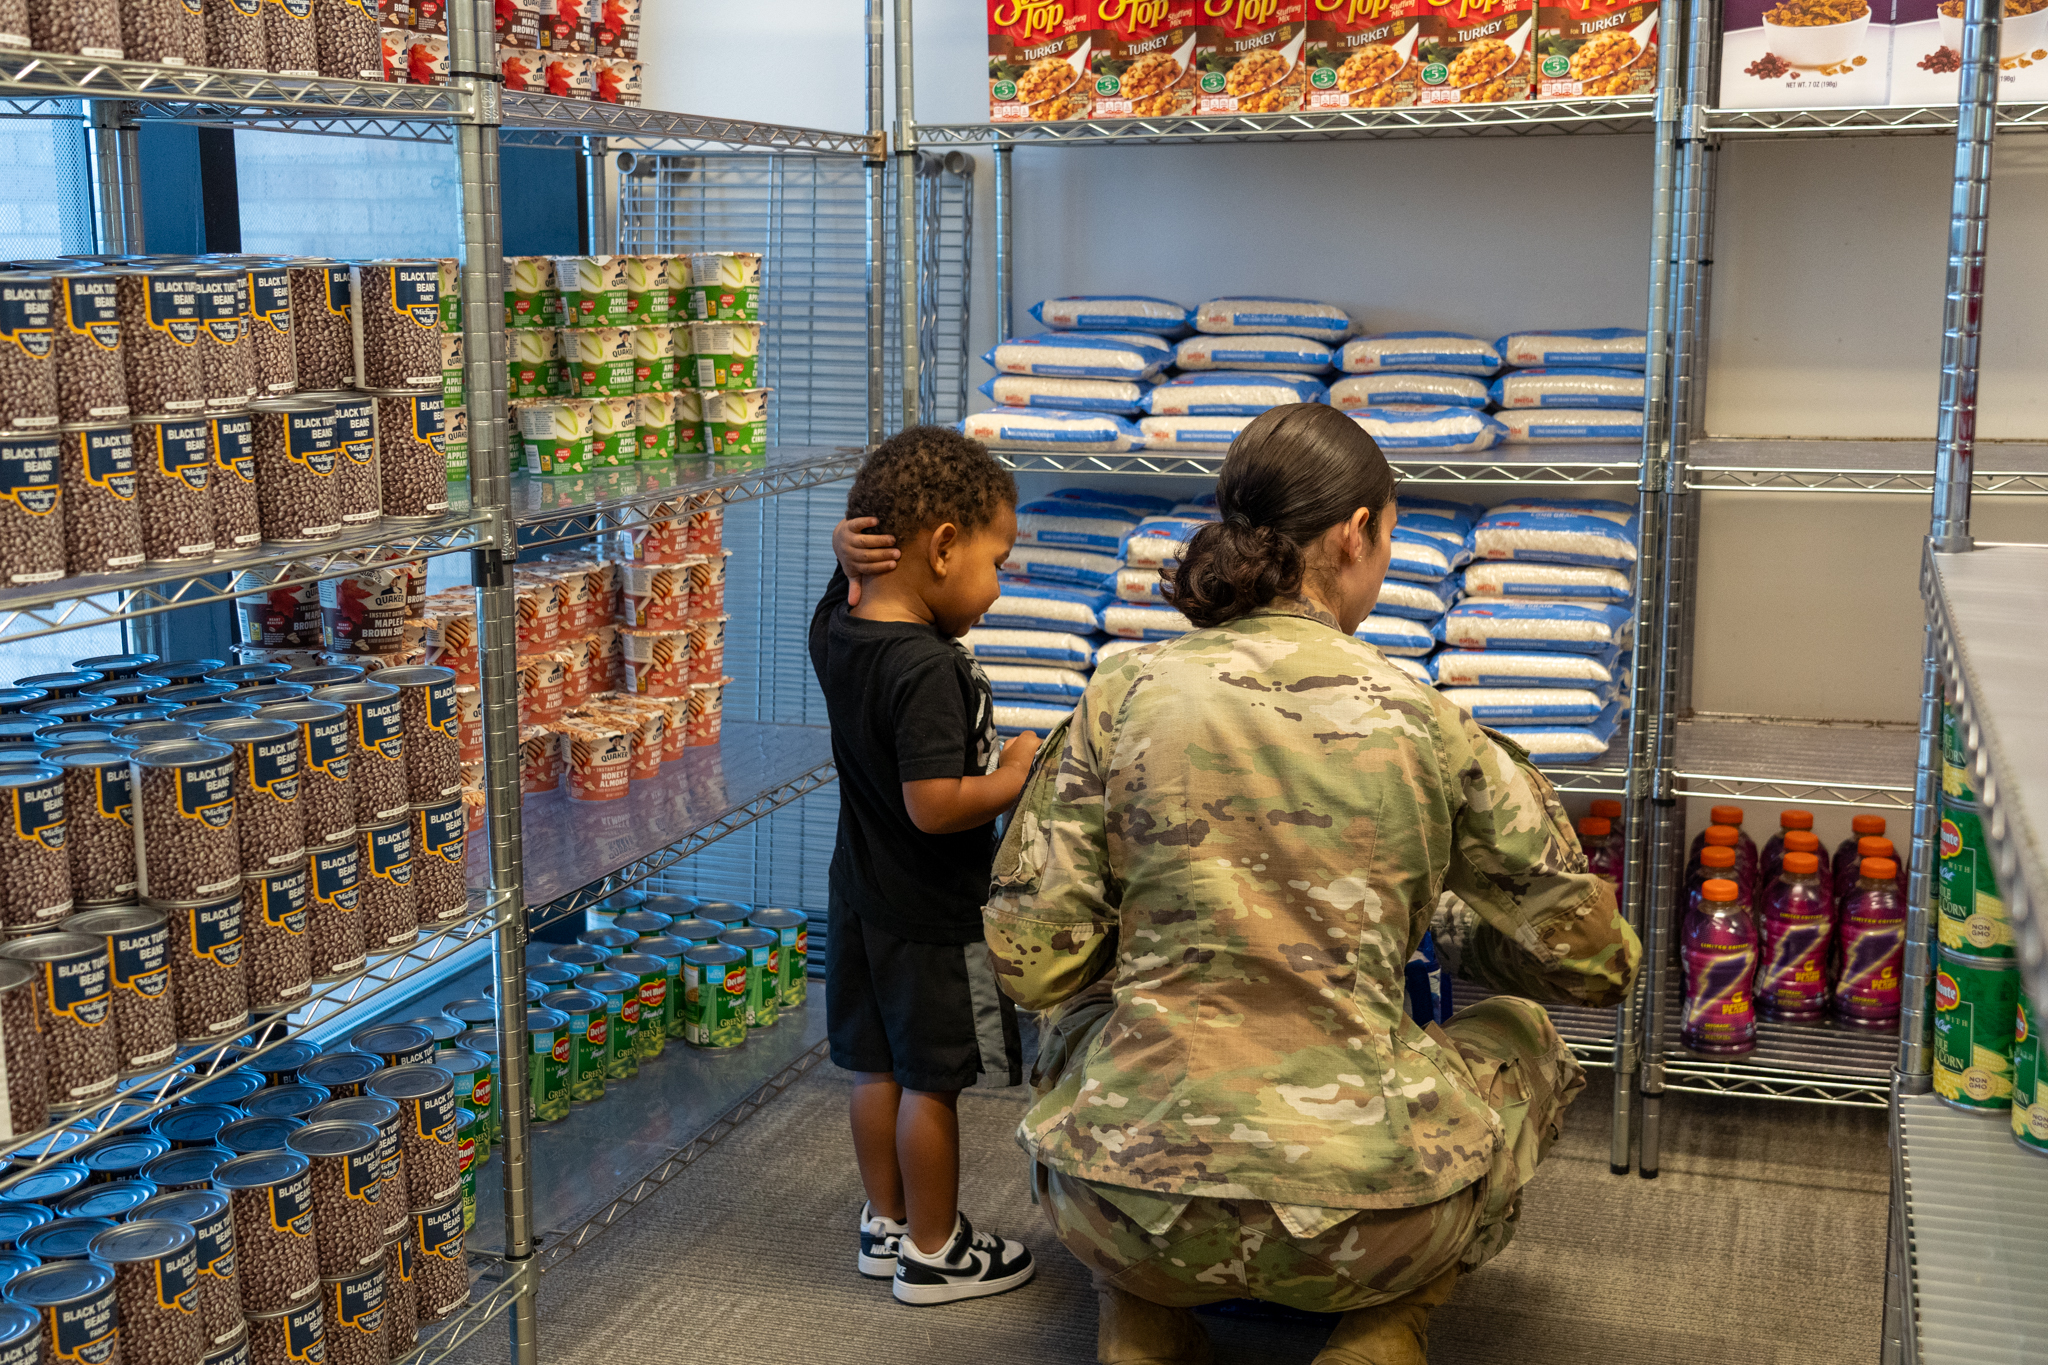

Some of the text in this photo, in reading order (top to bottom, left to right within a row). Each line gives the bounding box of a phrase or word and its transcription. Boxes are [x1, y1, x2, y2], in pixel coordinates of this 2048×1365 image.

[1580, 12, 1627, 35] TURKEY
[1346, 26, 1389, 47] TURKEY
[1458, 20, 1502, 42] TURKEY
[1128, 35, 1169, 56] TURKEY
[1234, 31, 1277, 52] TURKEY
[1023, 40, 1064, 61] TURKEY
[1552, 62, 1560, 72] 5
[1320, 74, 1328, 83] 5
[1431, 69, 1439, 79] 5
[1105, 82, 1112, 91] 5
[1210, 78, 1217, 88] 5
[1820, 81, 1838, 89] (198g)
[1001, 86, 1009, 95] 5
[258, 277, 280, 287] BLACK
[400, 272, 439, 282] BLACK TURT
[75, 284, 104, 295] BLACK
[155, 281, 184, 293] BLACK
[416, 283, 435, 293] BEANS
[3, 288, 37, 301] BLACK
[173, 294, 195, 305] BEANS
[213, 294, 235, 305] BEANS
[420, 401, 440, 411] BLACK
[335, 407, 359, 419] BLACK
[222, 423, 244, 434] BLACK
[294, 415, 336, 429] BLACK TURT
[350, 418, 370, 429] BEANS
[167, 428, 195, 440] BLACK
[311, 428, 333, 439] BEANS
[354, 430, 368, 438] FANCY
[92, 435, 121, 448] BLACK
[316, 440, 331, 448] FANCY
[2, 447, 37, 460] BLACK
[23, 460, 52, 473] BEANS
[375, 594, 404, 606] QUAKER
[374, 619, 398, 628] MAPLE
[362, 628, 393, 638] BROWN
[434, 688, 453, 700] BLACK
[367, 705, 391, 718] BLACK
[383, 713, 400, 727] BEANS
[315, 725, 339, 738] BLACK
[259, 743, 285, 757] BLACK
[601, 751, 628, 762] QUAKER
[276, 751, 297, 766] BEANS
[186, 768, 217, 783] BLACK
[601, 771, 624, 780] HONEY
[206, 776, 230, 792] BEANS
[600, 777, 628, 788] ALMONDS
[24, 787, 54, 803] BLACK
[430, 812, 453, 825] BLACK
[445, 819, 462, 832] BEANS
[377, 832, 401, 846] BLACK
[449, 829, 461, 839] FANCY
[393, 840, 410, 853] BEANS
[321, 856, 346, 870] BLACK
[397, 852, 410, 861] FANCY
[338, 864, 357, 878] BEANS
[1948, 862, 1971, 874] WITH
[272, 878, 297, 892] BLACK
[342, 875, 356, 886] FANCY
[1942, 898, 1967, 918] CORN
[201, 909, 229, 924] BLACK
[219, 914, 240, 932] BEANS
[1971, 923, 1991, 932] NON
[1971, 929, 1991, 938] GMO
[119, 927, 169, 952] BLACK TURT
[139, 942, 164, 960] BEANS
[144, 957, 163, 970] FANCY
[58, 963, 90, 978] BLACK
[79, 969, 105, 987] BEANS
[85, 984, 103, 997] FANCY
[1945, 1014, 1968, 1028] WITH
[640, 1029, 657, 1038] REEN
[1939, 1049, 1965, 1071] CORN
[1968, 1076, 1988, 1084] NON
[1968, 1082, 1988, 1091] GMO
[424, 1095, 447, 1109] BLACK
[439, 1099, 455, 1115] BEANS
[382, 1144, 396, 1157] FANCY
[353, 1152, 375, 1168] BLACK
[279, 1182, 303, 1198] BLACK
[427, 1212, 451, 1227] BLACK
[443, 1216, 461, 1232] BEANS
[198, 1223, 224, 1240] BLACK
[447, 1226, 460, 1238] FANCY
[166, 1256, 189, 1274] BLACK
[346, 1282, 372, 1295] BLACK
[363, 1285, 383, 1301] BEANS
[367, 1297, 381, 1309] FANCY
[62, 1305, 96, 1324] BLACK
[83, 1310, 111, 1331] BEANS
[294, 1312, 316, 1328] BLACK
